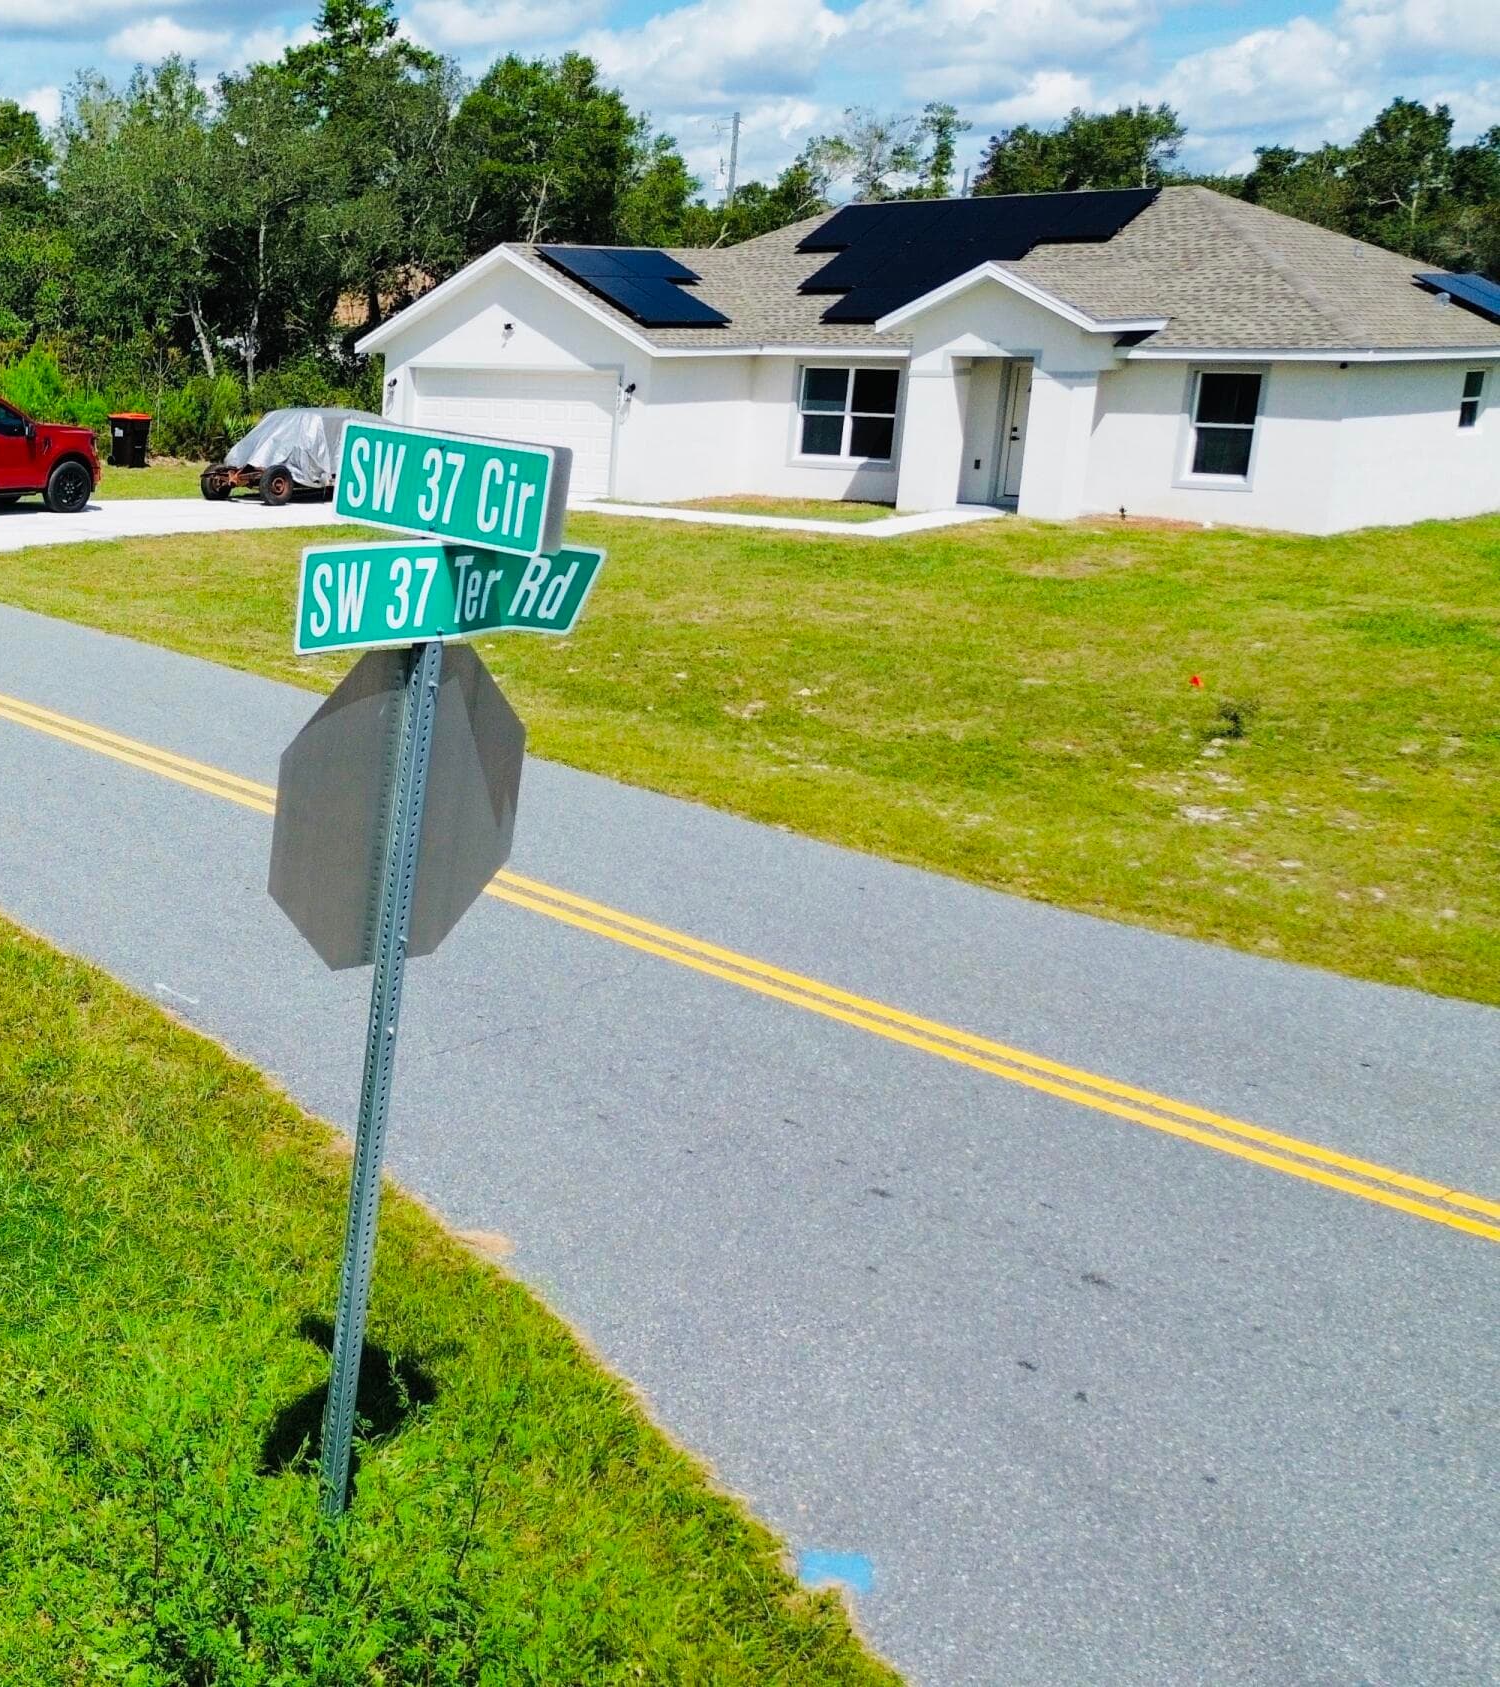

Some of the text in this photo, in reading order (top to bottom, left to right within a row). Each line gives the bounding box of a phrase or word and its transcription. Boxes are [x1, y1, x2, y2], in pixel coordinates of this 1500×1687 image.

[346, 437, 536, 538] SW 37 Cir
[310, 555, 580, 638] SW 37 Ter Rd
